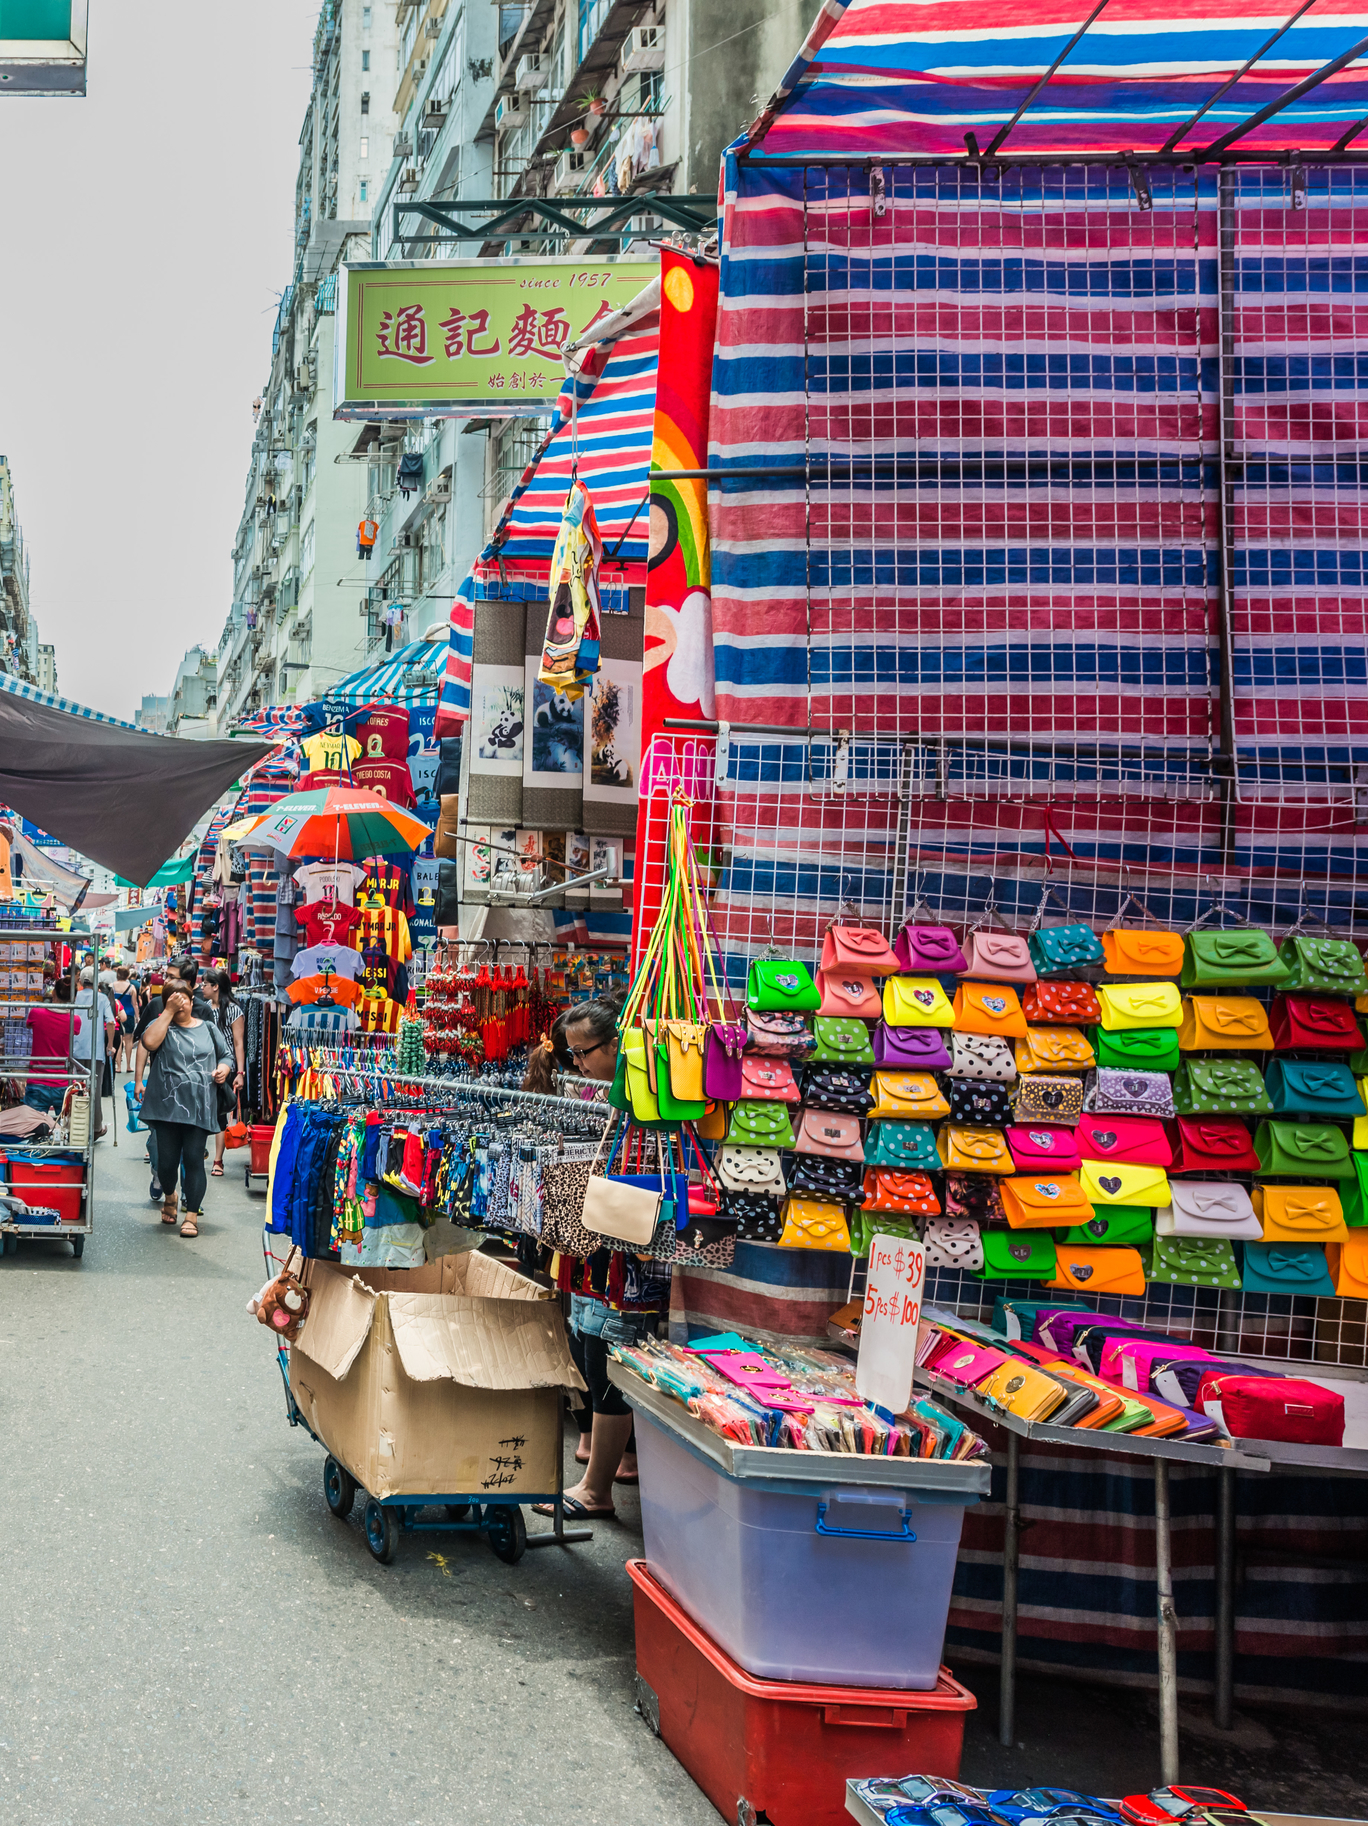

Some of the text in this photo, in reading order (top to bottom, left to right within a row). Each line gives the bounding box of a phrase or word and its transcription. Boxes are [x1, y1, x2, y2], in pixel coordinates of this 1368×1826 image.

[520, 272, 612, 288] since 1957
[322, 704, 349, 713] BENZEMA
[356, 770, 391, 780] DIEGO COSTA
[417, 872, 439, 880] BALE
[386, 922, 396, 931] JR
[356, 1010, 387, 1022] MESSI
